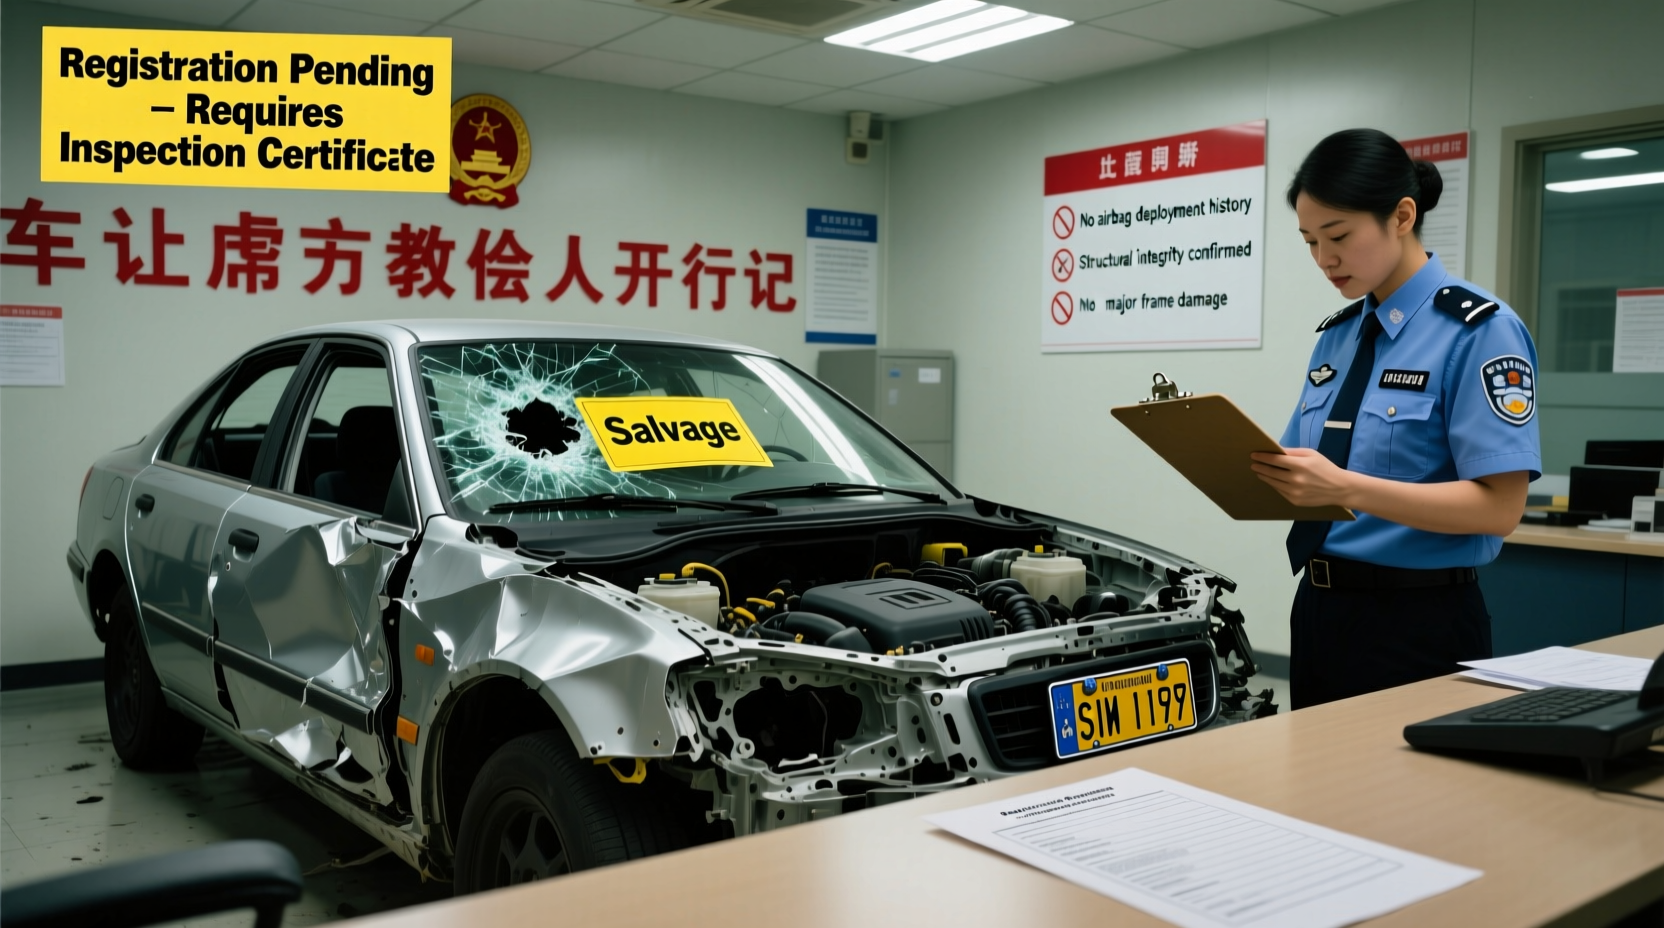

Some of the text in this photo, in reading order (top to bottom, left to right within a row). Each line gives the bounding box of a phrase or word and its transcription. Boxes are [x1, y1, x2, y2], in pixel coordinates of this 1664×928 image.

[61, 47, 434, 95] Registration Pending
[186, 93, 344, 134] Requires
[60, 131, 434, 172] Inspection Certificate
[1081, 197, 1251, 228] No airbag deployment history
[1137, 246, 1184, 267] integrity
[1188, 241, 1251, 261] confirmed
[1106, 295, 1137, 315] major
[1142, 293, 1174, 309] frame
[1178, 292, 1227, 310] damage
[604, 415, 741, 448] Salvage
